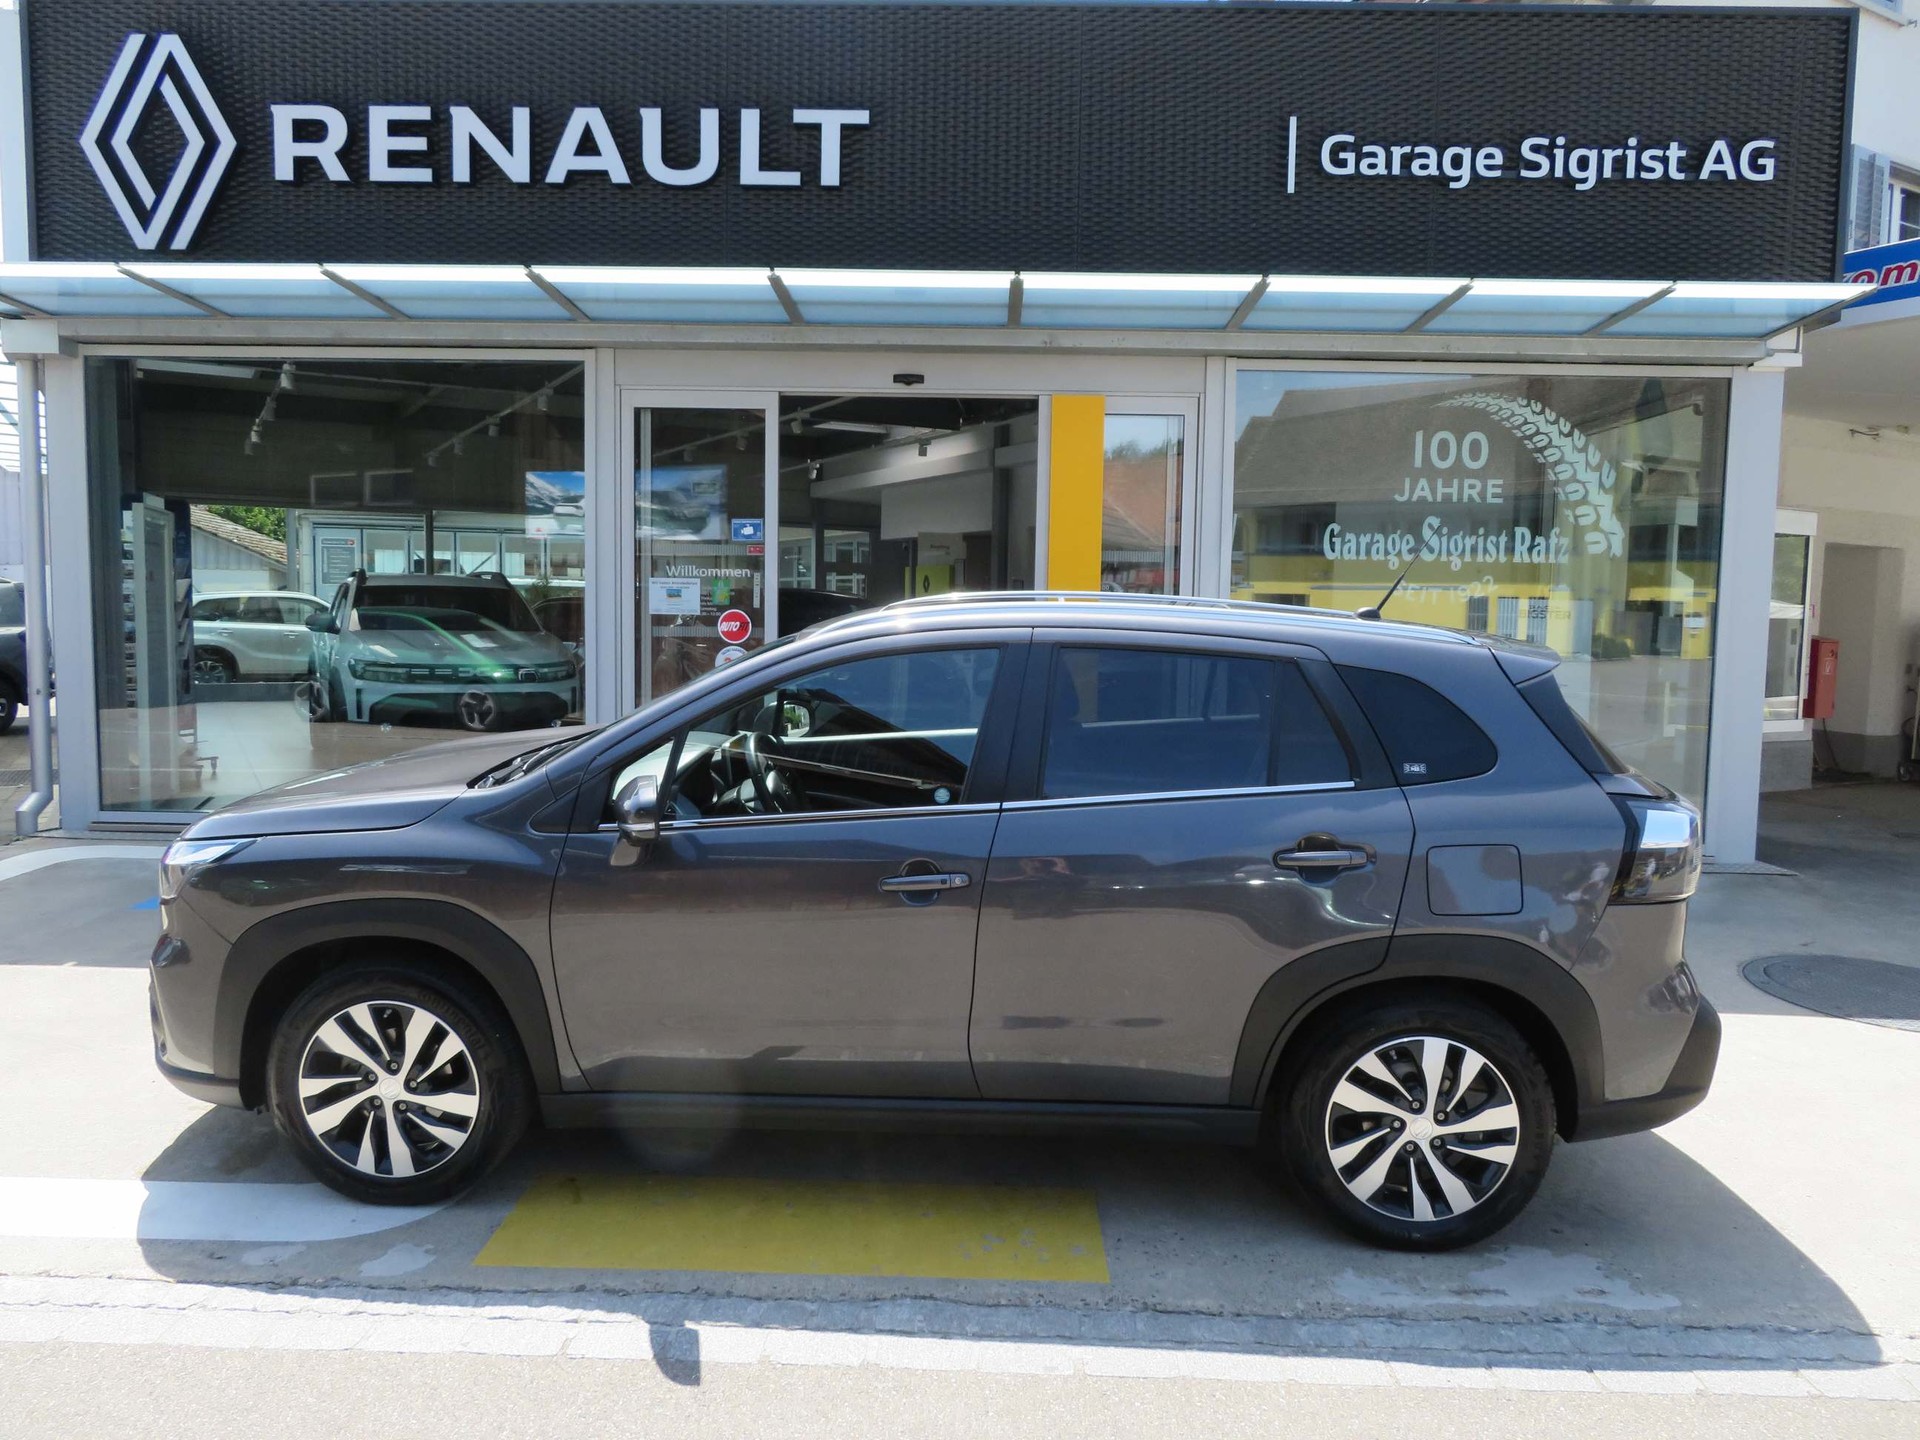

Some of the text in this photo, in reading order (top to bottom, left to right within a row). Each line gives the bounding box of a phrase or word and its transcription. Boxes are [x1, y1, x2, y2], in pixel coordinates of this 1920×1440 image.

[271, 104, 870, 187] RENAULT
[1321, 134, 1775, 191] Garage Sigrist AG
[1413, 429, 1490, 470] 100
[1393, 478, 1504, 504] JAHRE
[1323, 516, 1569, 571] Garage Sigrist Rafz
[666, 565, 751, 578] Willkommen
[1449, 575, 1499, 603] 1922
